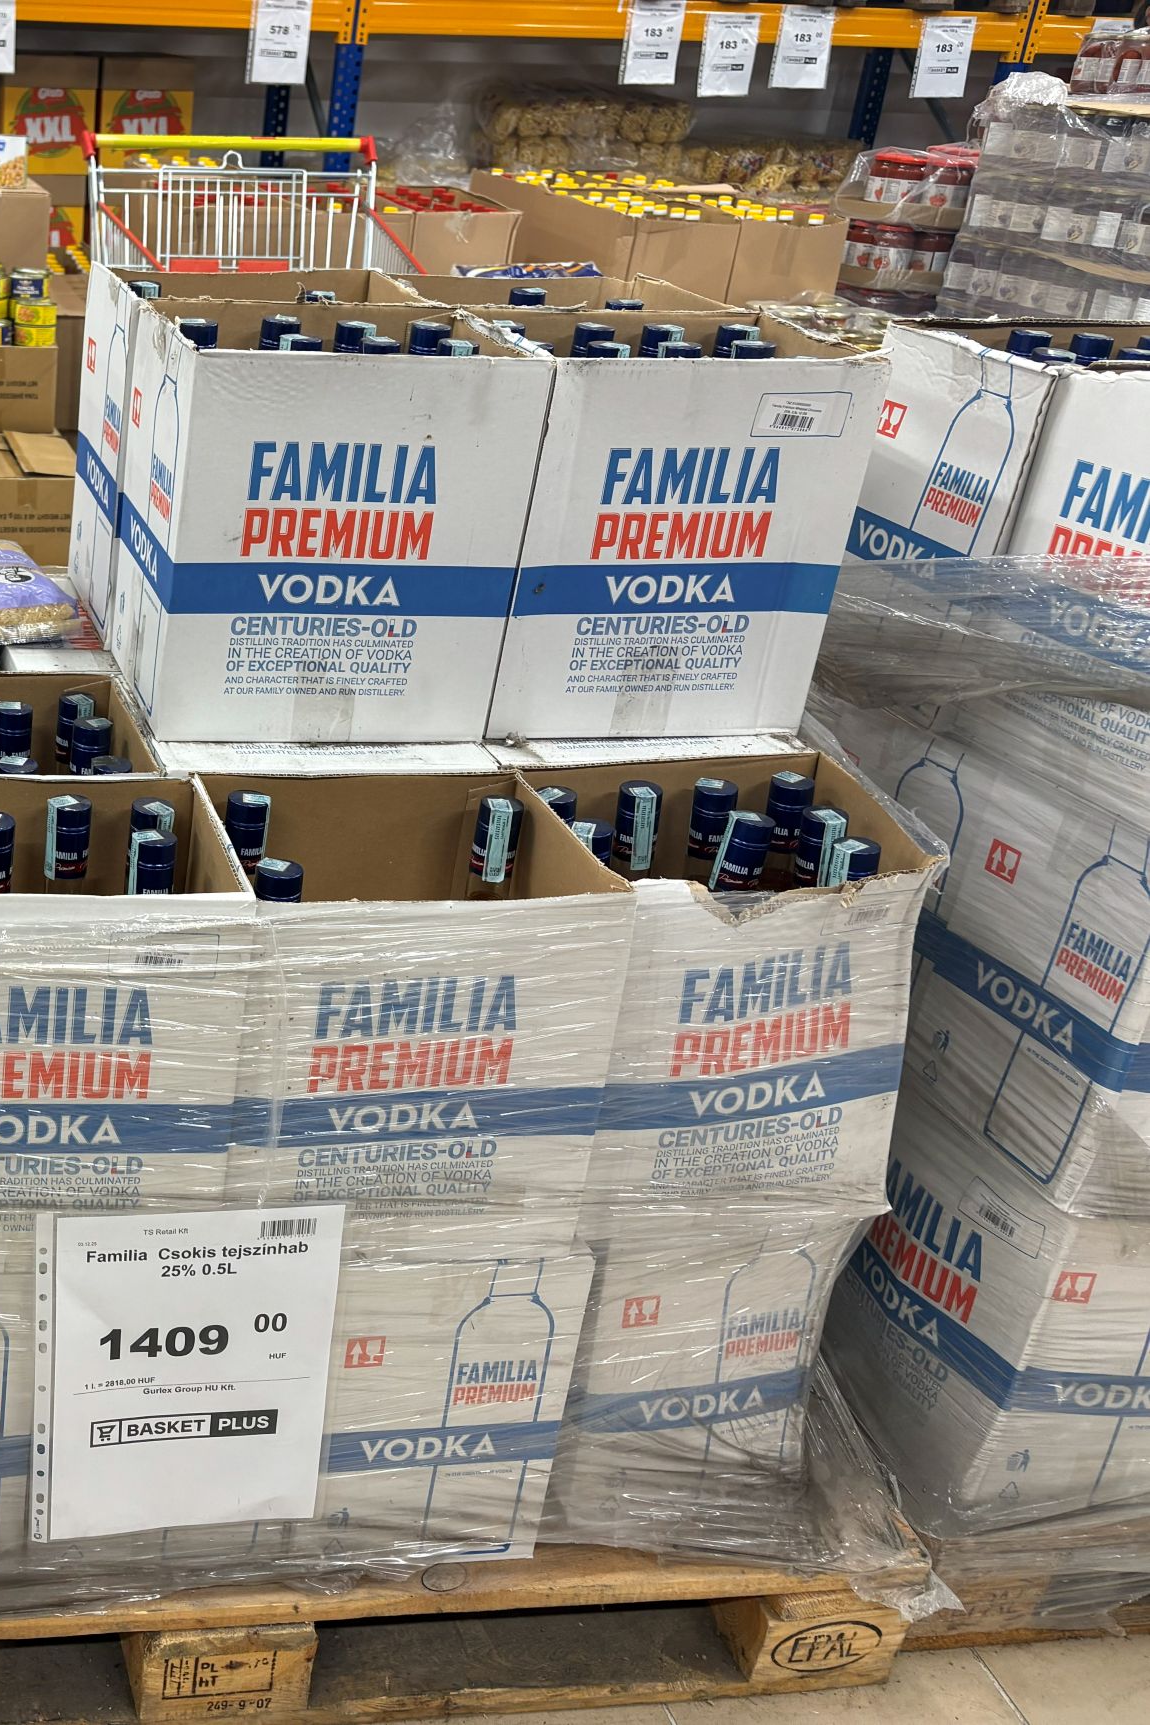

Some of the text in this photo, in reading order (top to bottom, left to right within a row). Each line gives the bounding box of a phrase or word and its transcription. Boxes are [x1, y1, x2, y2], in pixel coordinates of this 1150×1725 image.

[644, 28, 662, 38] 183
[719, 40, 738, 50] 183
[794, 33, 812, 43] 183
[936, 43, 953, 53] 183
[24, 115, 76, 142] XXL
[121, 117, 169, 137] XXL
[86, 450, 110, 511] VODKA
[151, 452, 173, 498] FAMILIA
[247, 440, 437, 504] FAMILIA
[599, 446, 781, 505] FAMILIA
[931, 461, 990, 504] FAMILIA
[923, 487, 982, 528] PREMIUM
[1059, 458, 1150, 544] FAMI
[130, 513, 158, 584] VODKA
[240, 508, 435, 561] PREMIUM
[589, 510, 772, 560] PREMIUM
[858, 519, 938, 581] VODKA
[258, 574, 400, 608] VODKA
[606, 574, 736, 605] VODKA
[230, 616, 418, 638] CENTURIES-OLD
[575, 613, 750, 637] CENTURIES-OLD
[721, 860, 749, 876] FAMILIA
[1062, 921, 1133, 984] FAMILIA
[678, 940, 852, 1024] FAMILIA
[1055, 946, 1126, 1004] PREMIUM
[314, 974, 517, 1040] FAMILIA
[976, 960, 1075, 1056] VODKA
[670, 1001, 851, 1077] PREMIUM
[306, 1036, 514, 1093] PREMIUM
[688, 1070, 826, 1118] VODKA
[328, 1100, 478, 1132] VODKA
[156, 1228, 176, 1236] Retail
[886, 1157, 983, 1283] AMILIA
[86, 1241, 309, 1263] Familia Csokis tejszínhab
[161, 1262, 238, 1278] 25% 0.5L
[870, 1213, 978, 1325] REMIUM
[862, 1246, 939, 1347] VODKA
[254, 1313, 288, 1333] 00
[725, 1307, 802, 1340] FAMILIA
[100, 1325, 230, 1360] 1409
[268, 1352, 287, 1360] HUF
[724, 1330, 800, 1361] PREMIUM
[138, 1376, 156, 1384] HUF
[456, 1360, 538, 1385] FAMILIA
[143, 1387, 172, 1395] Gurlex
[174, 1386, 203, 1395] Group
[220, 1384, 236, 1392] Kft.
[452, 1383, 537, 1406] PREMIUM
[638, 1385, 764, 1424] VODKA
[1055, 1381, 1150, 1409] VODK
[126, 1416, 270, 1437] BASKET PLUS
[359, 1432, 496, 1464] VODKA
[788, 1631, 862, 1663] EPAL
[199, 1675, 219, 1688] HT
